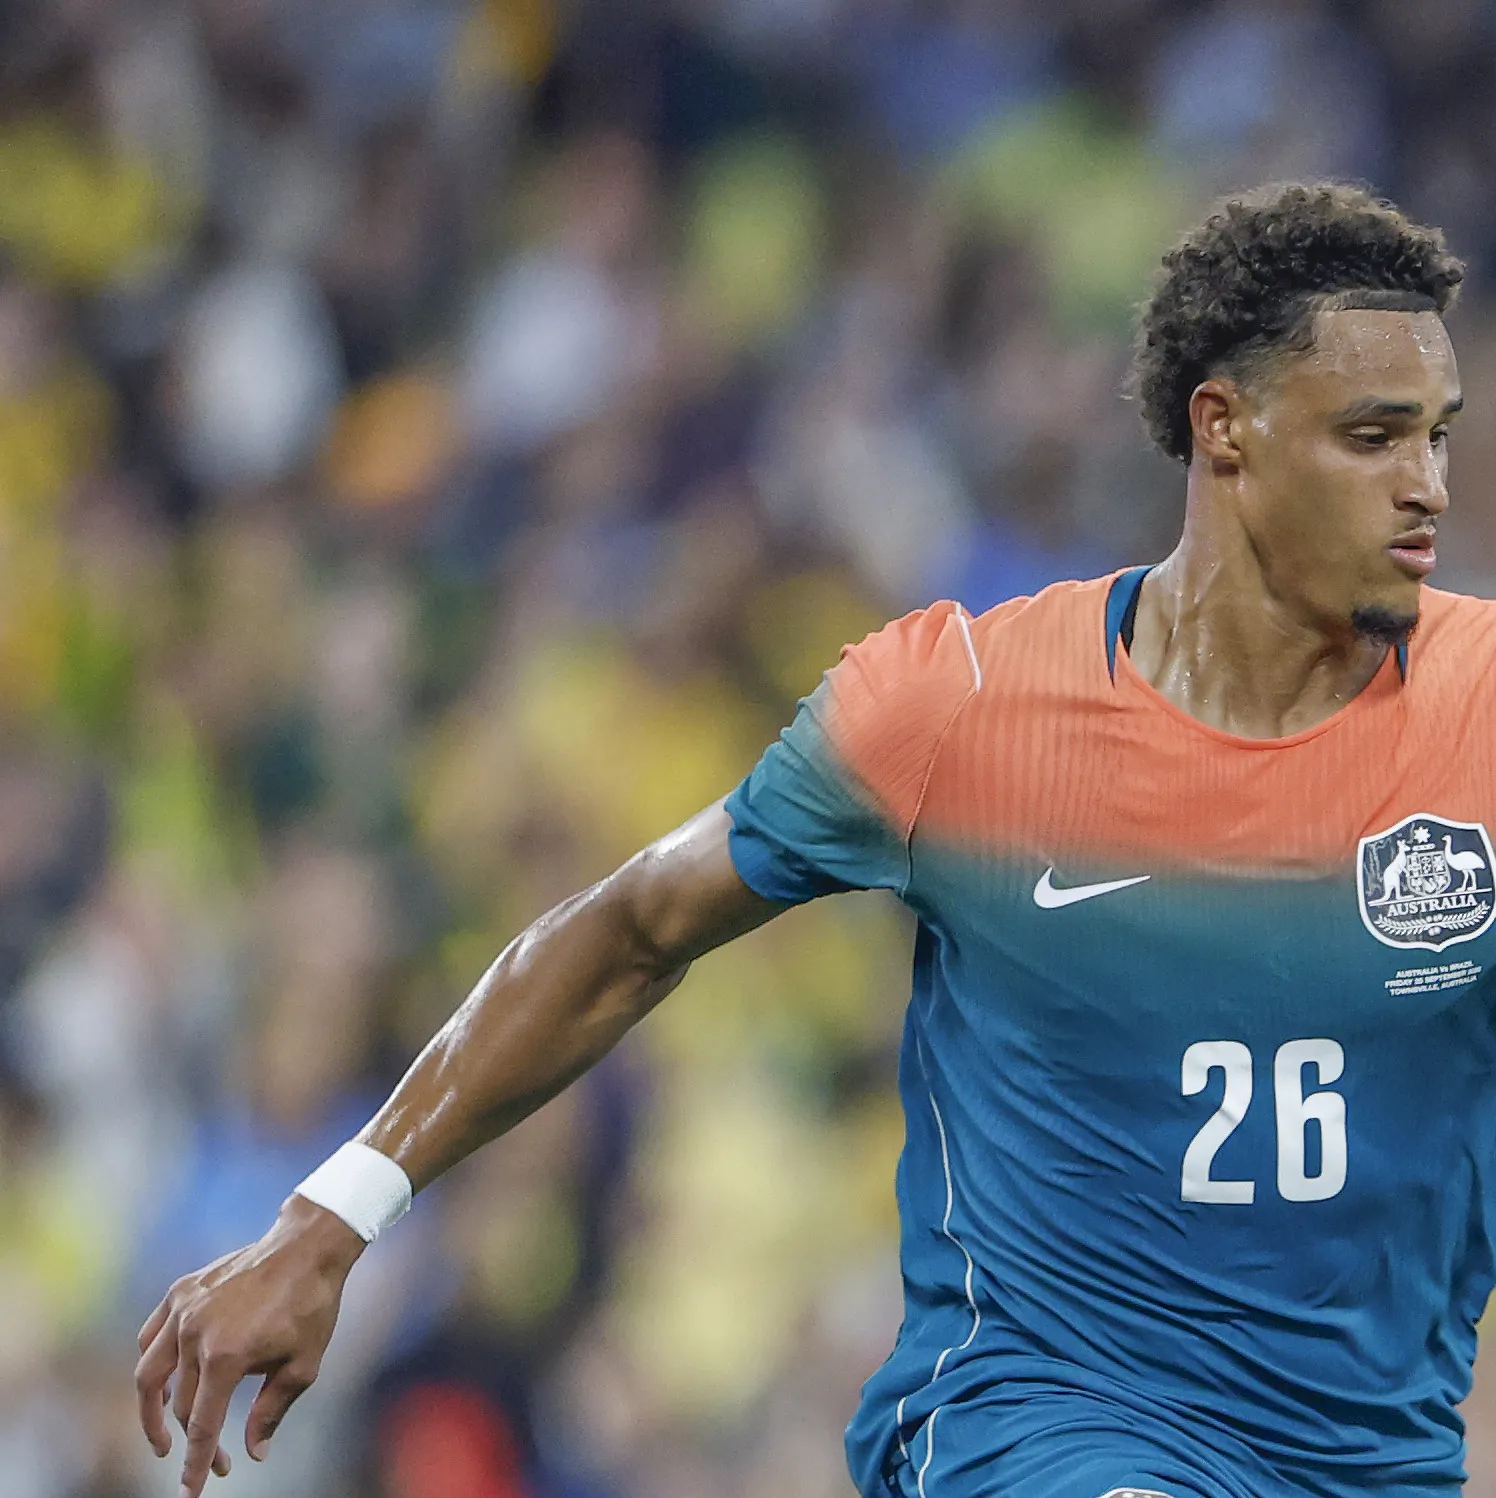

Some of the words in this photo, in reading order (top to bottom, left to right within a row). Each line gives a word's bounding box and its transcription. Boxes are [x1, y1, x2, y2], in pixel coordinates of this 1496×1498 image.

[1387, 894, 1478, 917] AUSTRALIA
[1385, 978, 1412, 988] FRIDAY
[1425, 969, 1466, 983] SEPTEMBER
[1396, 966, 1438, 978] AUSTRALIA
[1441, 975, 1477, 989] AUSTRALIA
[1181, 1038, 1348, 1204] 26
